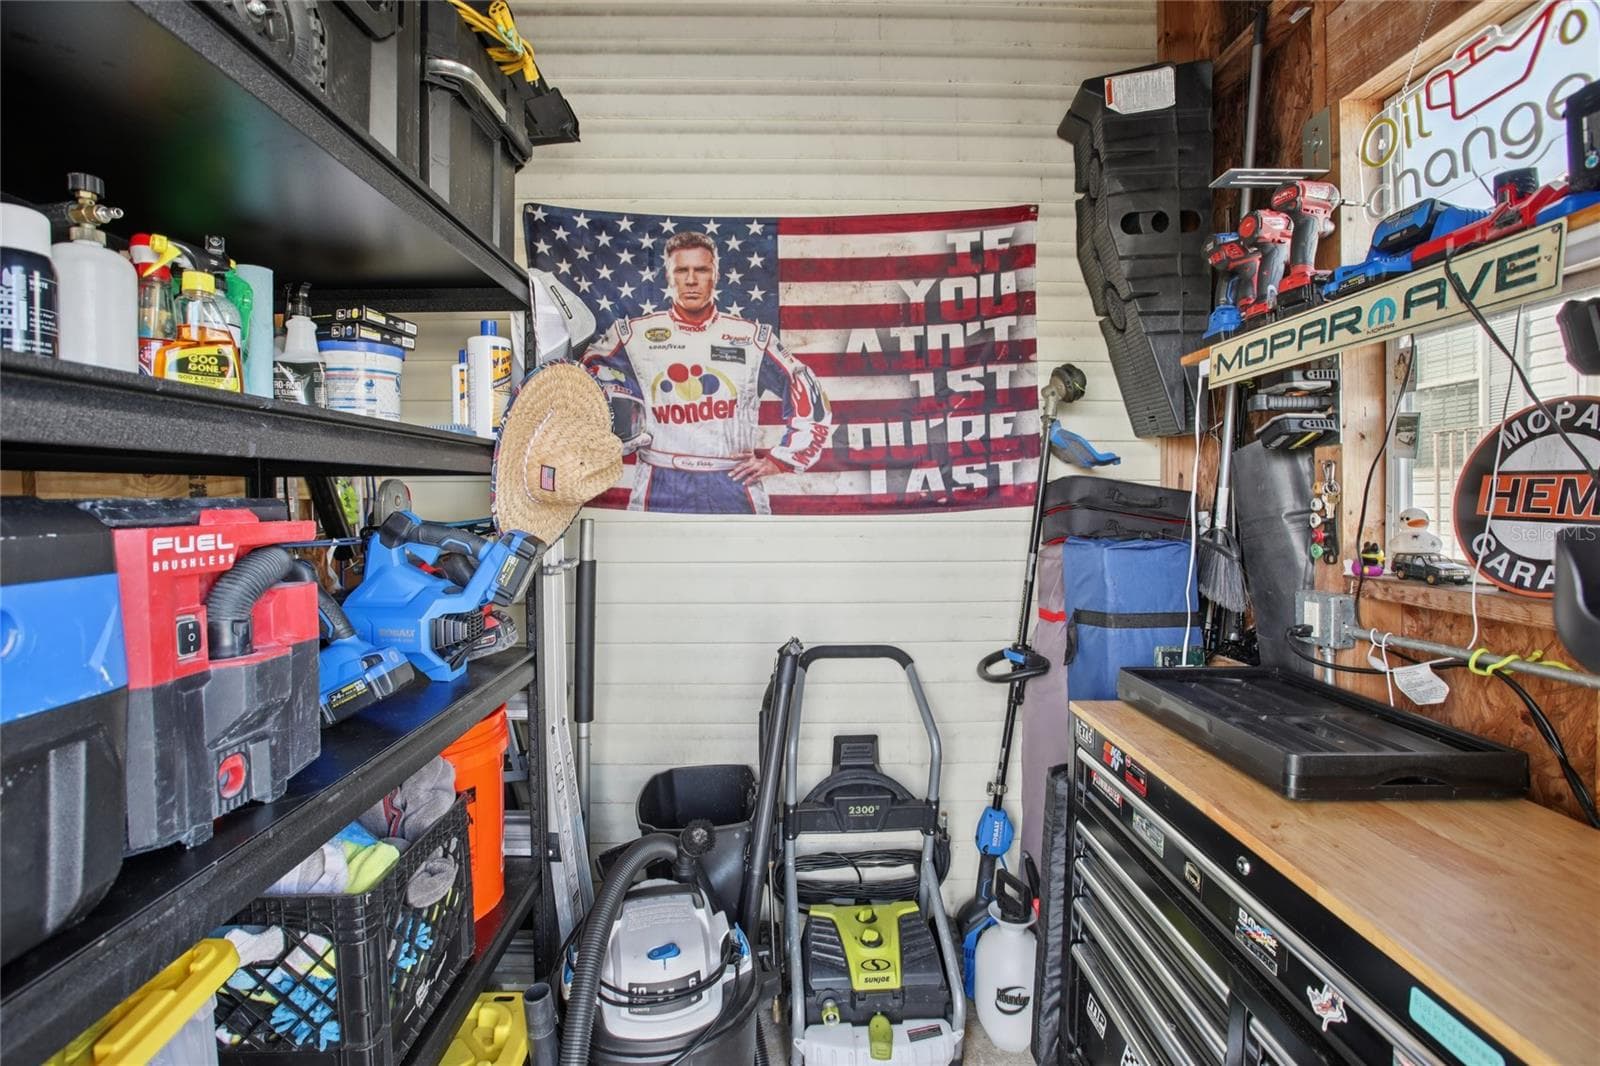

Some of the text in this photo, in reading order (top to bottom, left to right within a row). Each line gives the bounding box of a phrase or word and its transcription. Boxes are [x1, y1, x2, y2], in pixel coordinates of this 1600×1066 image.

[1367, 73, 1594, 222] change
[946, 228, 1016, 275] IF
[899, 271, 1018, 324] YOU
[1215, 305, 1363, 378] MOPAR
[1403, 245, 1541, 321] AVE
[188, 354, 218, 365] GOO
[842, 315, 1017, 372] AIN'T
[187, 363, 219, 374] GONE
[910, 364, 1019, 412] 1ST
[651, 396, 738, 425] wonder
[1499, 403, 1600, 450] MOPA
[869, 459, 1022, 504] LAST
[152, 534, 234, 556] FUEL
[153, 553, 235, 573] BRUSHLESS
[848, 806, 875, 814] 2300
